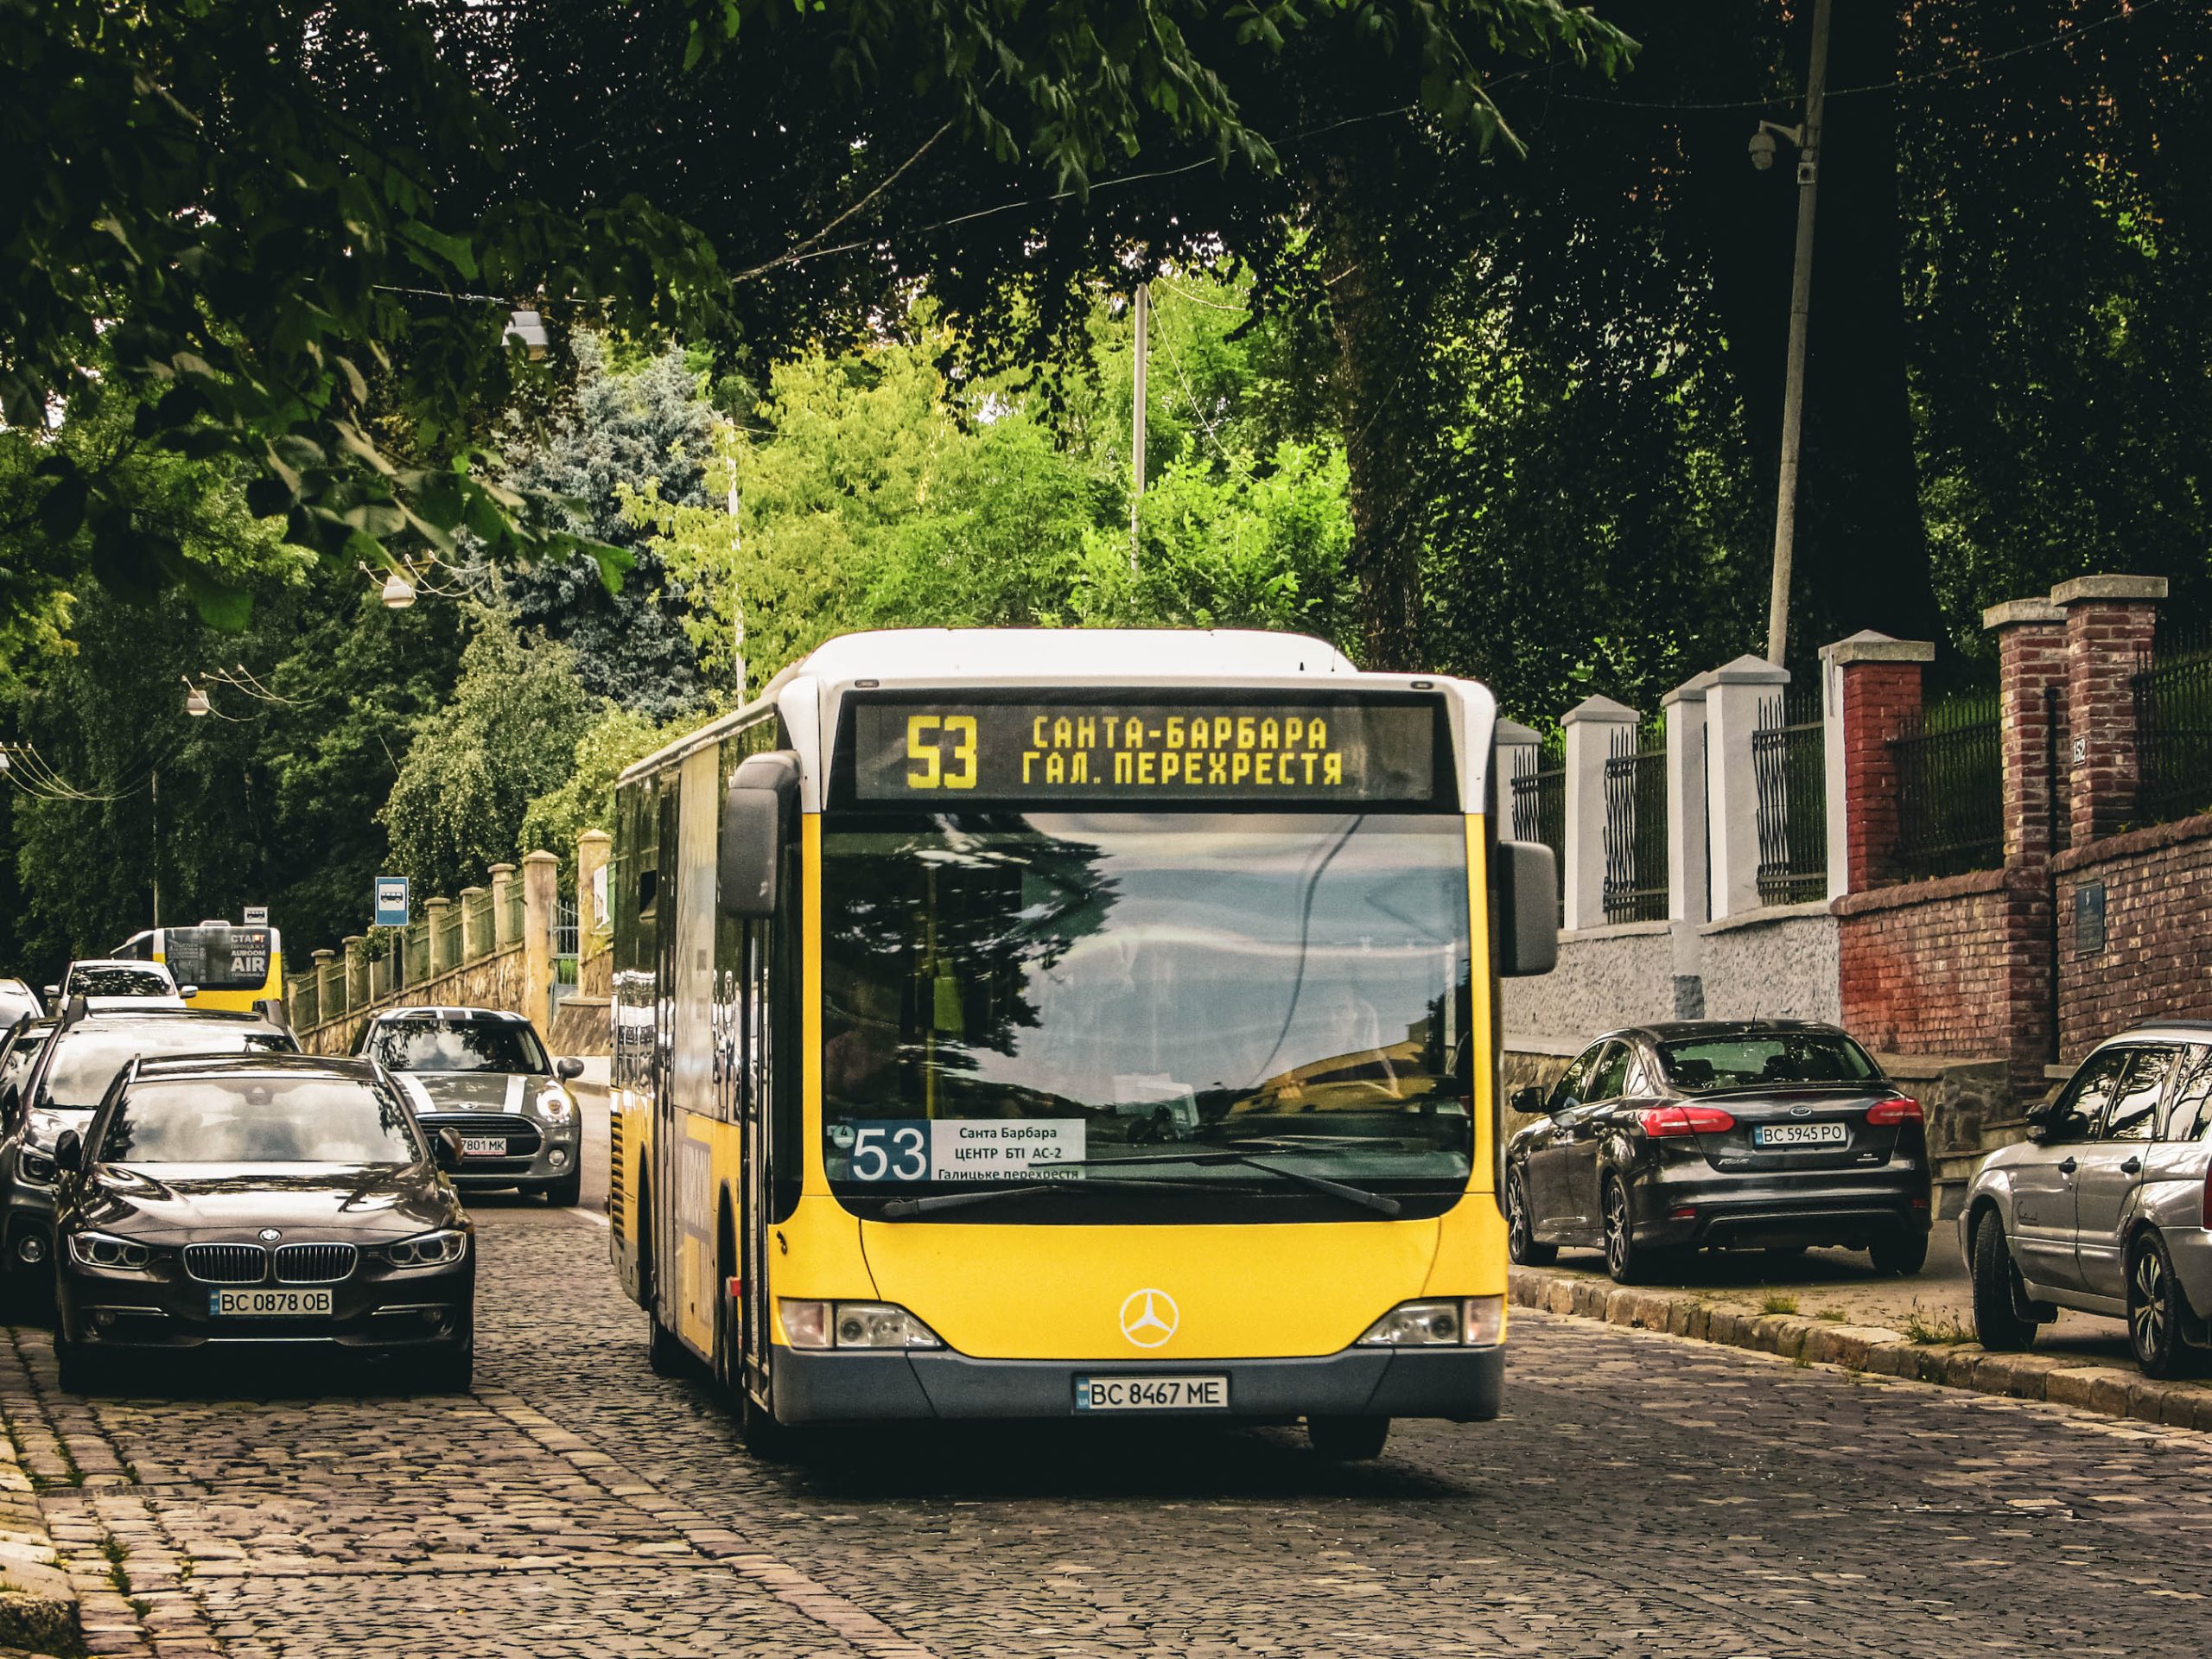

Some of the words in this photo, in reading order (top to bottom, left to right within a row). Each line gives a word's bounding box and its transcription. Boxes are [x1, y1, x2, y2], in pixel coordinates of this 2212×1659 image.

[1033, 715, 1326, 749] САНТА-БАРБАРА
[907, 715, 977, 788] 53
[2074, 738, 2085, 762] 152
[1023, 752, 1101, 785] ГАЛ.
[1115, 751, 1342, 785] ПЕРЕХРЕСТЯ
[231, 957, 265, 972] AIR
[959, 1128, 997, 1138] Санта
[1001, 1127, 1058, 1140] Барбара
[1764, 1128, 1783, 1142] BC
[1787, 1127, 1818, 1141] 5945
[1821, 1126, 1841, 1140] PO
[461, 1140, 486, 1150] 7801
[489, 1140, 505, 1150] MK
[852, 1128, 927, 1180] 53
[955, 1147, 998, 1160] ЦЕНТР
[1006, 1147, 1025, 1159] БТІ
[1033, 1147, 1062, 1159] АС-2
[938, 1169, 1000, 1180] Галицьке
[1004, 1169, 1079, 1180] перехрестя
[221, 1294, 249, 1311] BC
[253, 1294, 298, 1311] 0878
[302, 1293, 330, 1311] OB
[1091, 1383, 1122, 1405] BC
[1129, 1382, 1180, 1404] 8467
[1187, 1382, 1219, 1403] ME
